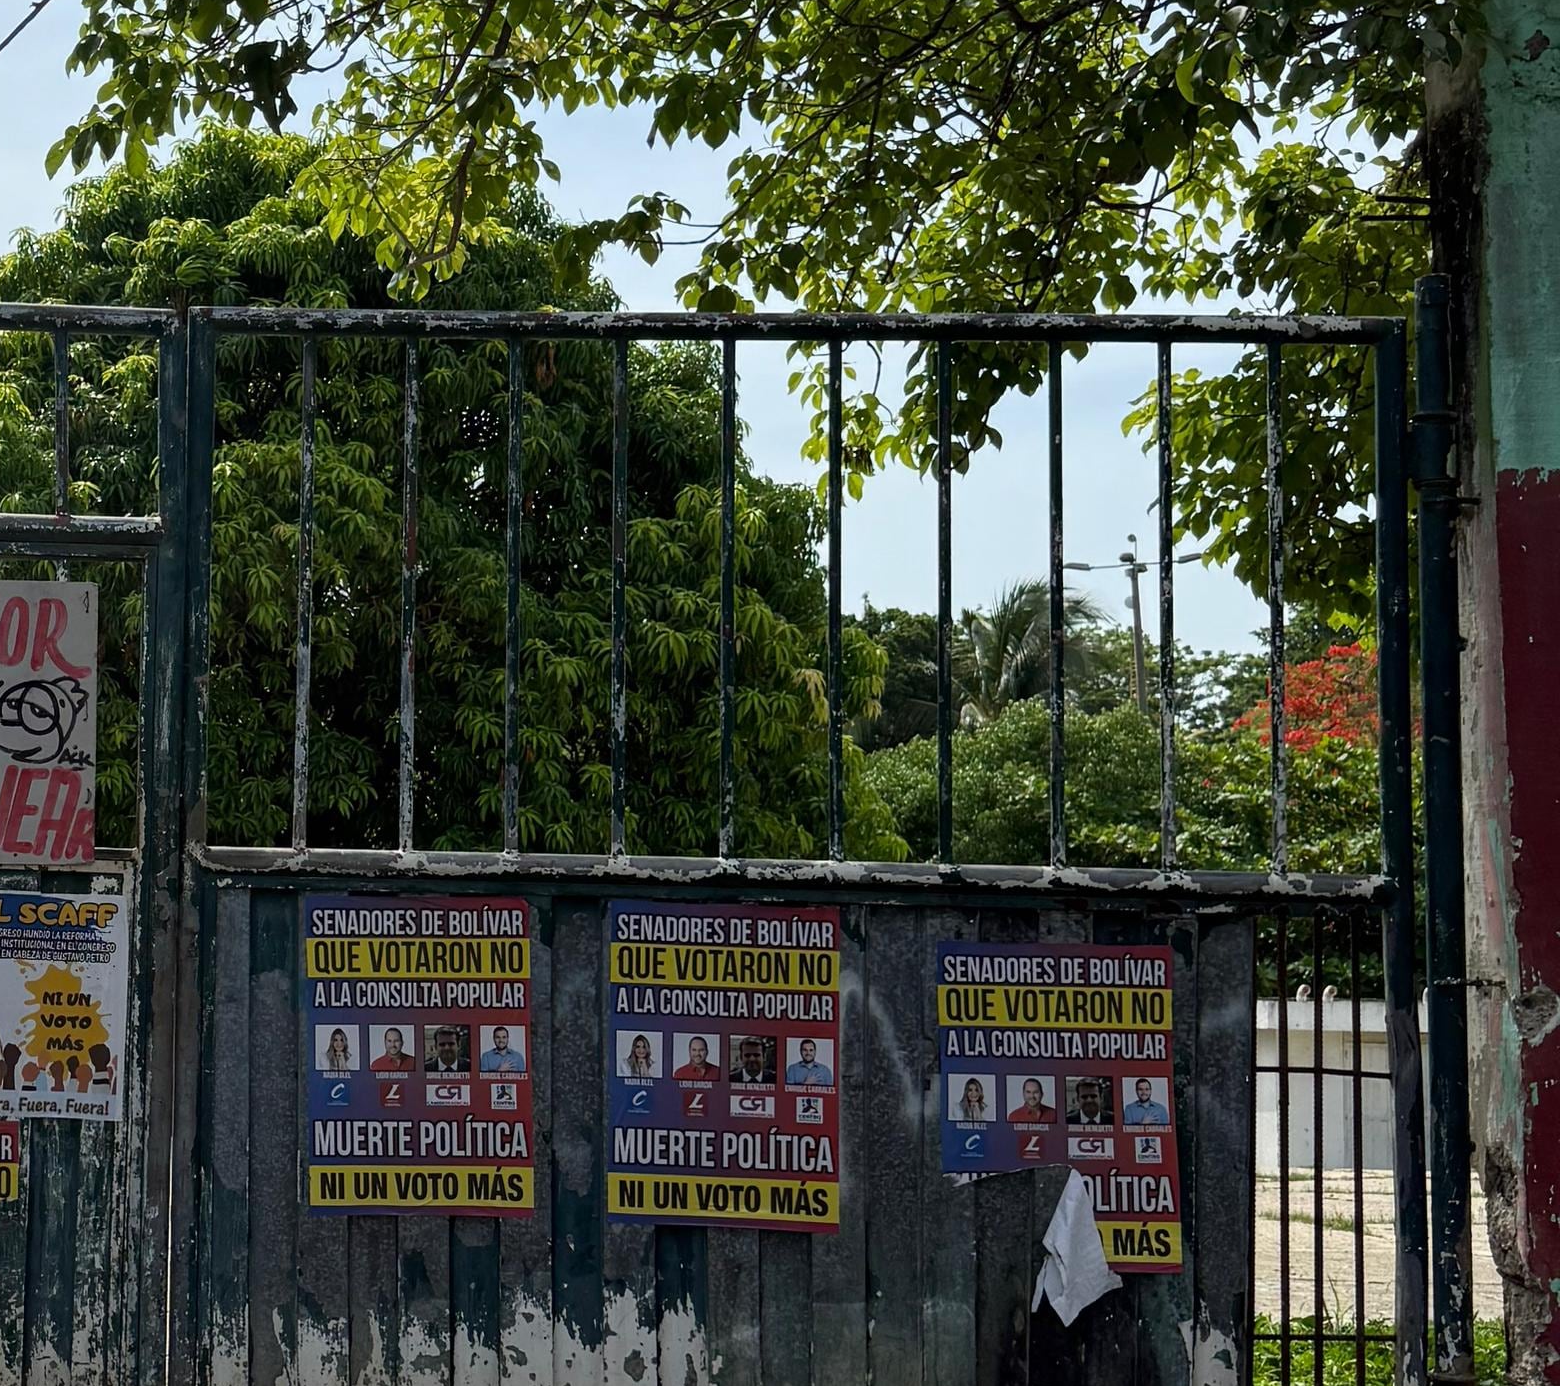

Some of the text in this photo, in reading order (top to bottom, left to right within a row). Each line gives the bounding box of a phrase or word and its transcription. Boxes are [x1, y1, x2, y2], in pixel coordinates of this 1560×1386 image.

[19, 901, 117, 927] SCAFF
[312, 906, 523, 936] SENADORES DE BOLÍVAR
[617, 914, 833, 948] SENADORES DE BOLÍVAR
[314, 941, 523, 974] QUE VOTARON NO
[618, 946, 833, 986] QUE VOTARON NO
[944, 955, 1164, 988] SENADORES DE BOLÍVAR
[43, 991, 91, 1007] NI UN
[315, 982, 524, 1008] A LA CONSULTA POPULAR
[618, 987, 833, 1021] A LA CONSULTA POPULAR
[946, 987, 1165, 1025] QUE VOTARON NO
[41, 1014, 92, 1030] VOTO
[47, 1034, 84, 1051] MÁS
[947, 1030, 1167, 1060] A LA CONSULTA POPULAR
[18, 1097, 61, 1114] Fuera,
[66, 1098, 109, 1115] Fuera!
[315, 1115, 527, 1157] MUERTE POLÍTICA
[614, 1126, 833, 1172] MUERTE POLÍTICA
[320, 1167, 523, 1201] NI UN VOTO MÁS
[619, 1180, 827, 1217] NI UN VOTO MÁS
[1083, 1169, 1175, 1213] LÍTICA
[1113, 1222, 1170, 1258] MÁS
